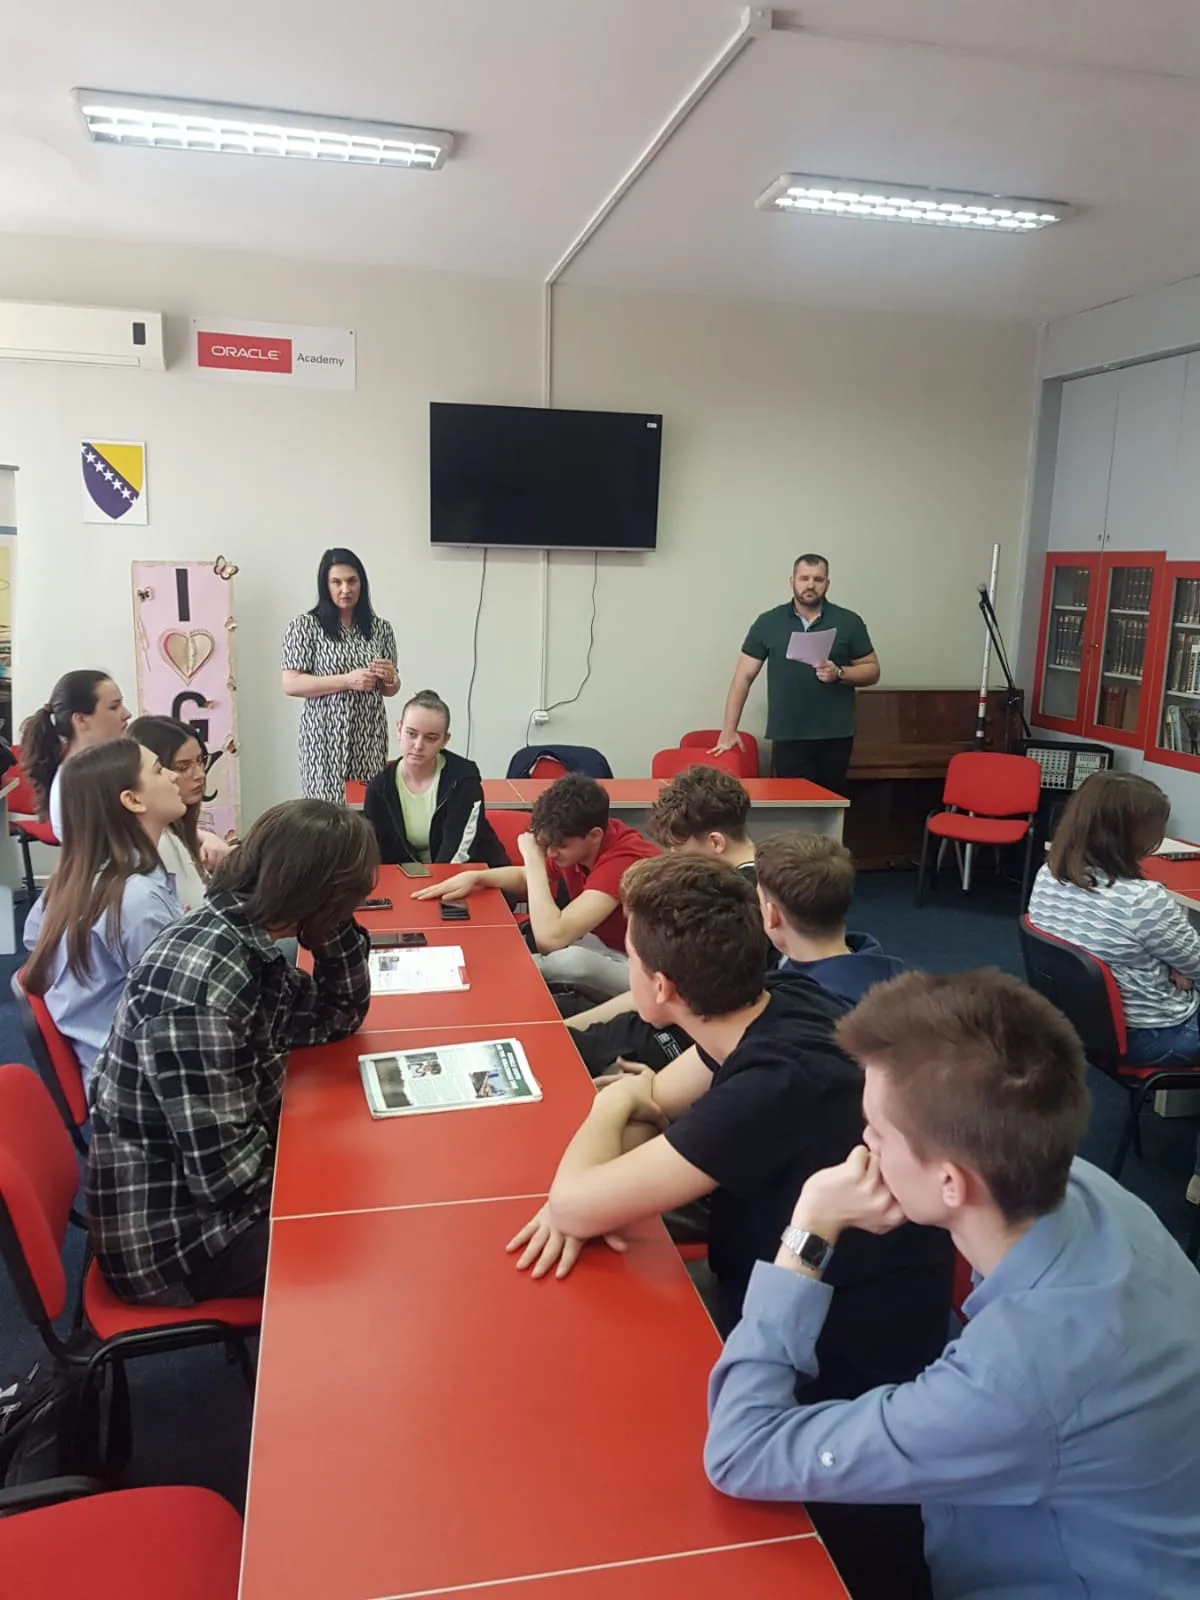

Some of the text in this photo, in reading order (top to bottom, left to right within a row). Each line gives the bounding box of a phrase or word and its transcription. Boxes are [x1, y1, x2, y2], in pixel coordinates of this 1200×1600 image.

[210, 345, 345, 367] ORACLE Academy
[175, 568, 191, 622] I
